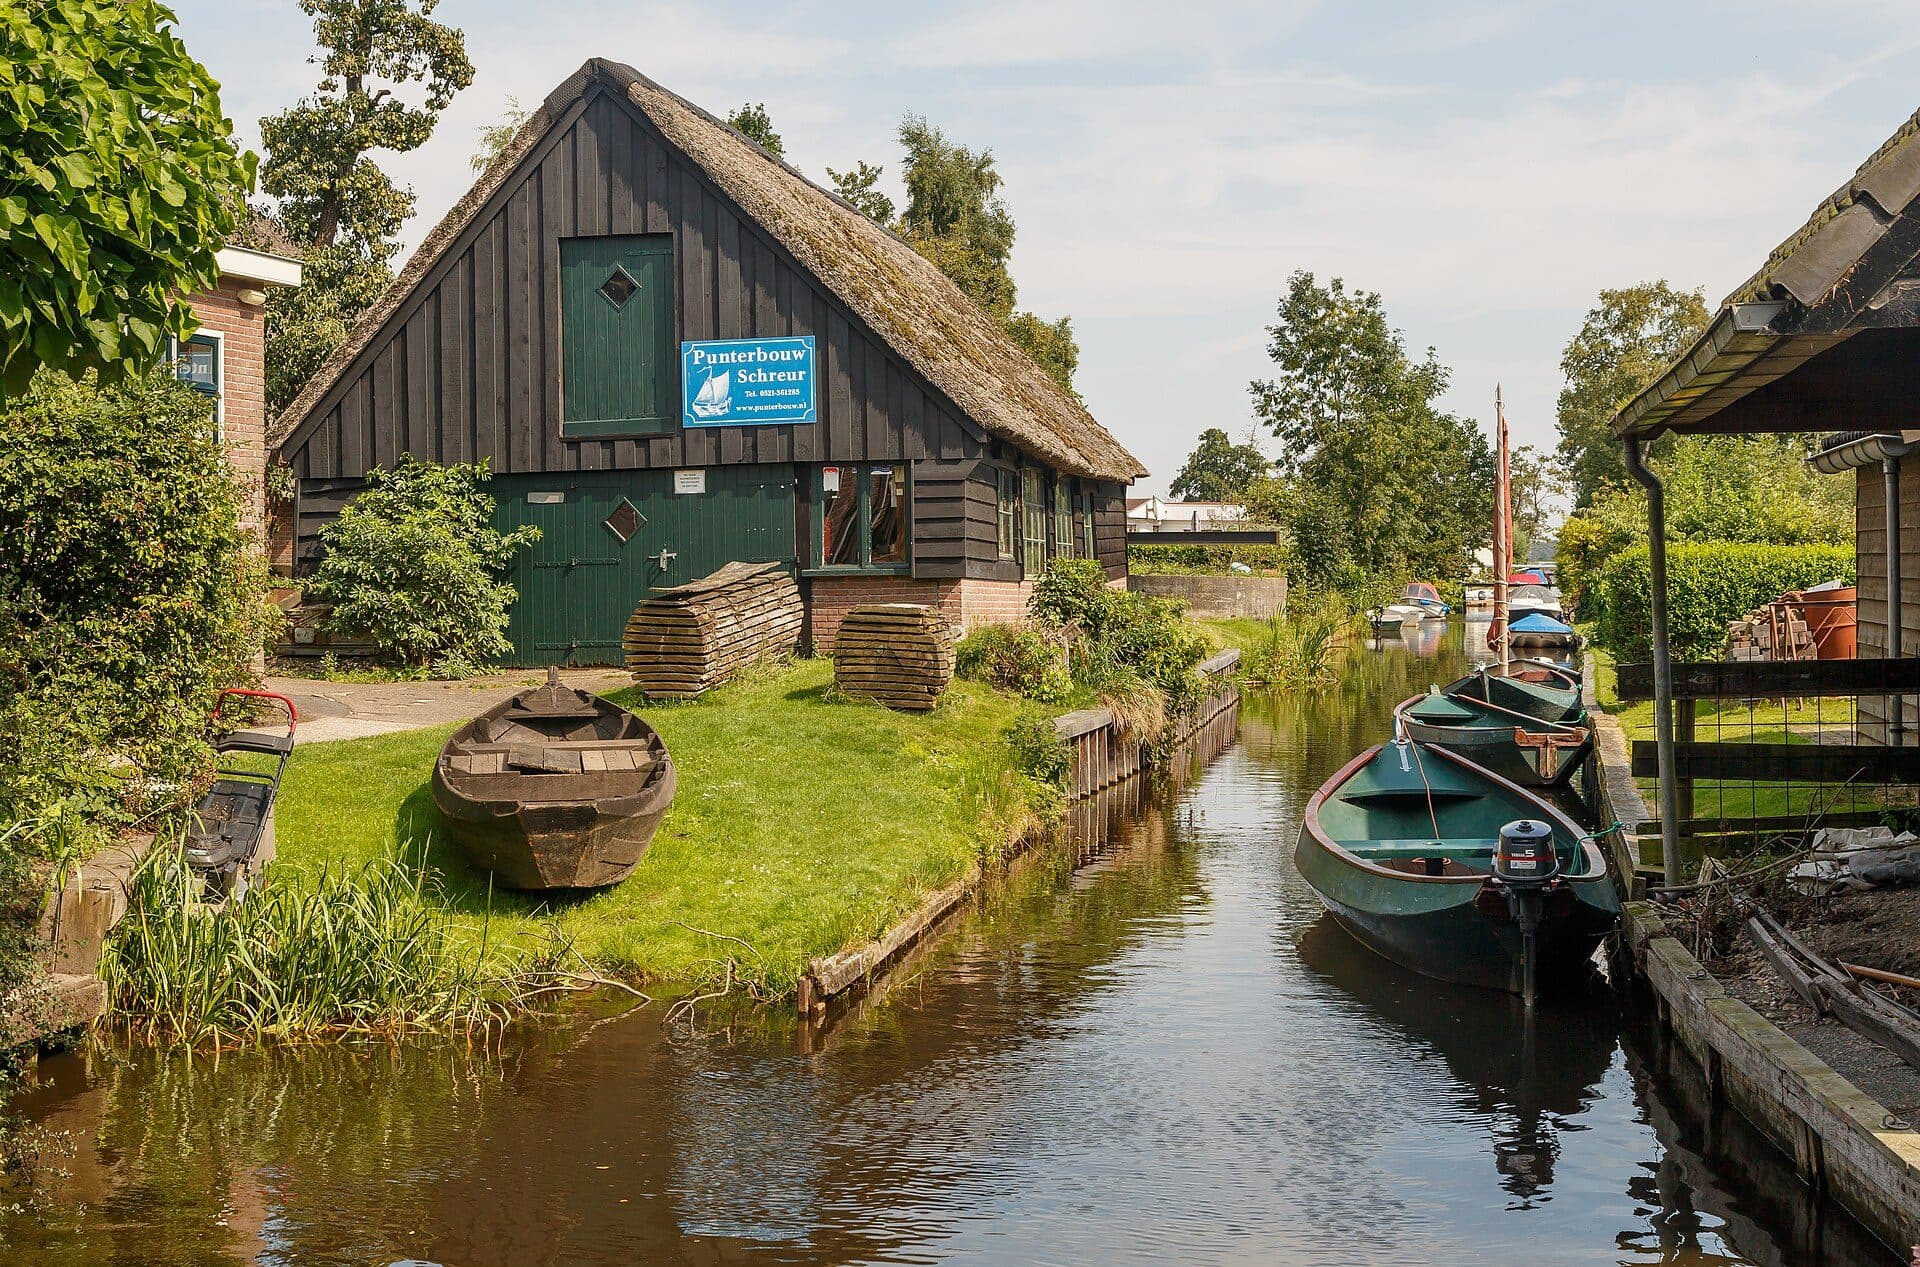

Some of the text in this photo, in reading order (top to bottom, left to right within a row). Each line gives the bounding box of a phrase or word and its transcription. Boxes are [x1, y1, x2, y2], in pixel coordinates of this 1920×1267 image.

[693, 347, 806, 365] Punterbouw
[737, 368, 806, 384] Schreur
[735, 401, 807, 413] www.punterbouw.nl
[1525, 849, 1535, 857] 5
